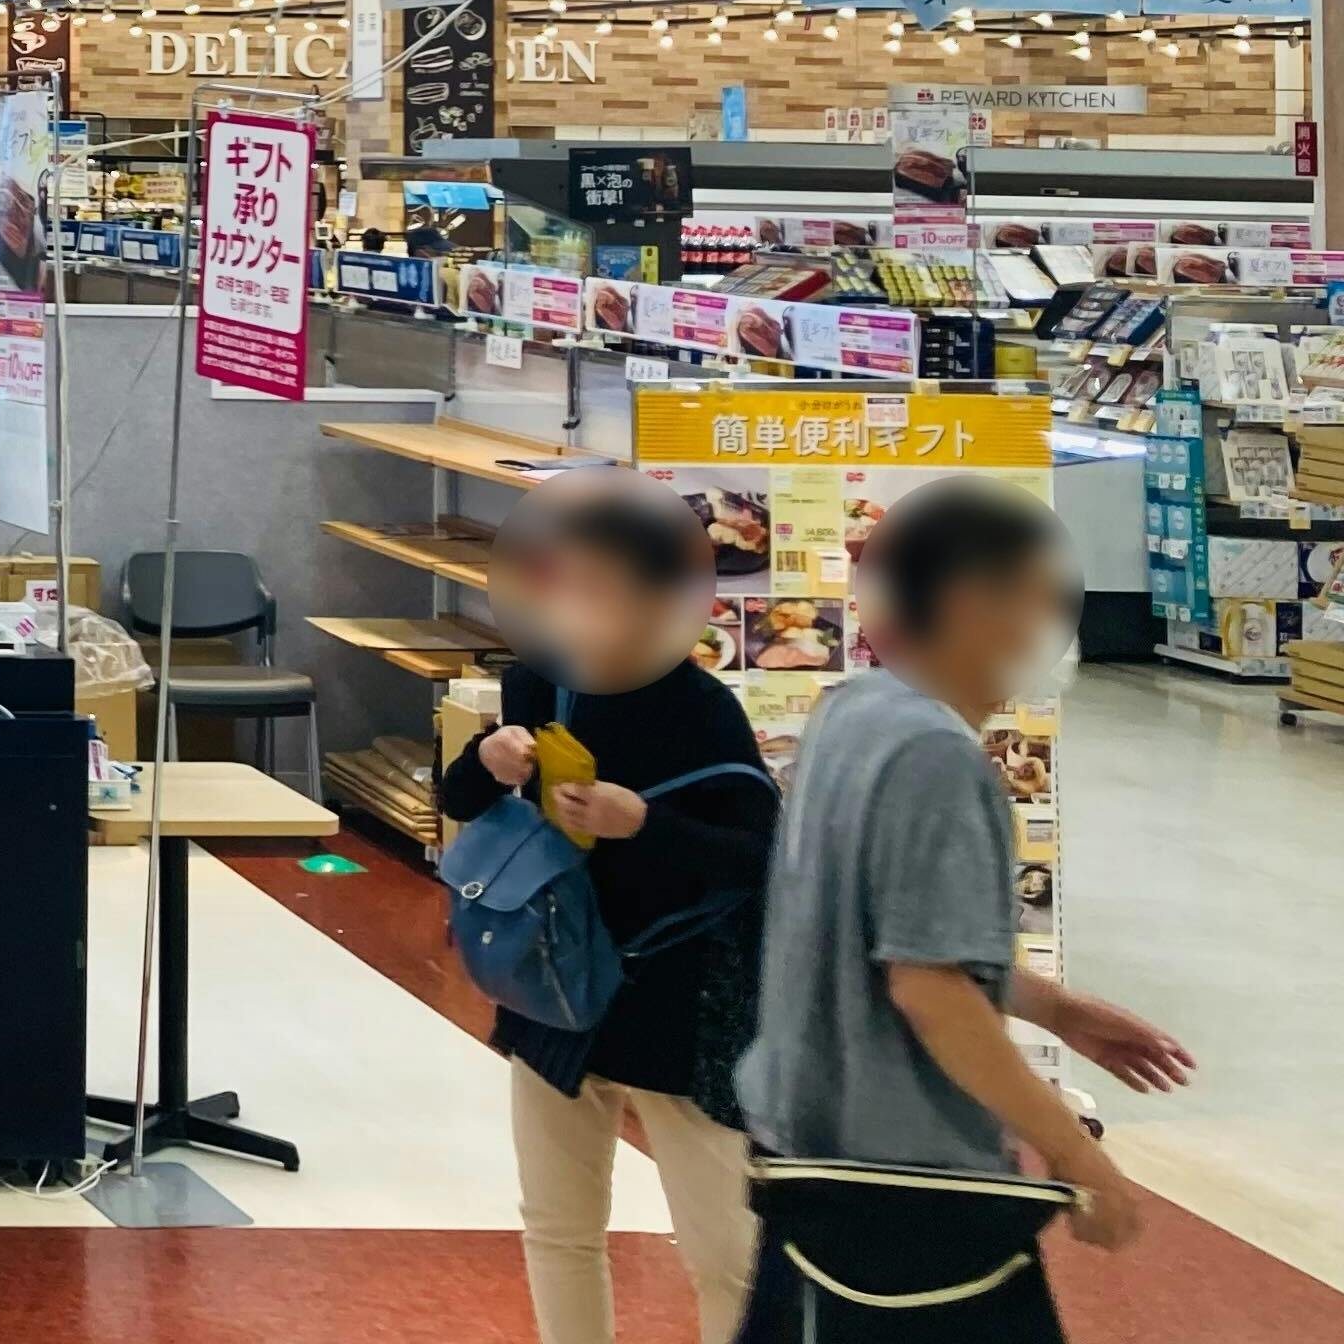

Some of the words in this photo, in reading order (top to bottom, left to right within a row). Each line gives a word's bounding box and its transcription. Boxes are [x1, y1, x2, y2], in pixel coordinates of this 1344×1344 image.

[940, 90, 1022, 106] REWARD
[225, 136, 293, 183] ギフト
[233, 183, 278, 227] 承り
[210, 225, 300, 274] カウンター
